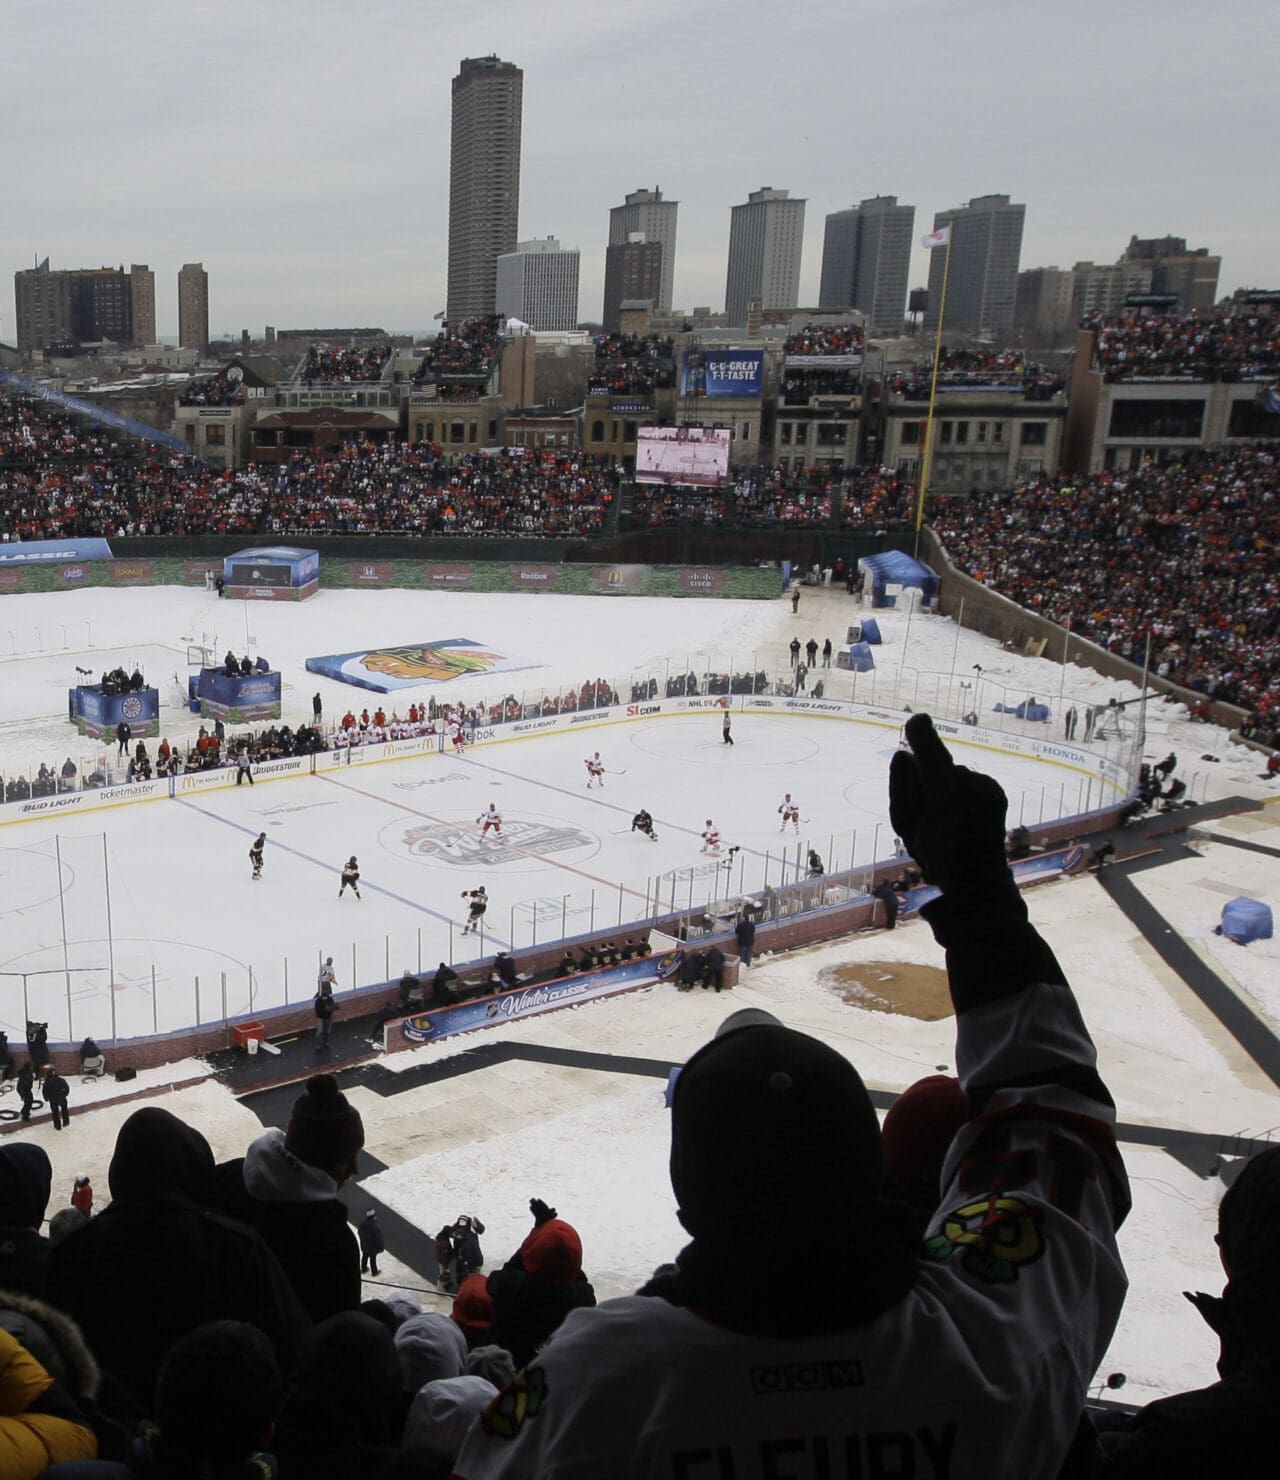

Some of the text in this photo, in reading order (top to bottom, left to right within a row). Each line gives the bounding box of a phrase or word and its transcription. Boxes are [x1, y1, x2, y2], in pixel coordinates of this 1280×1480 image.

[712, 371, 755, 380] T-T-TASTE
[520, 572, 548, 580] Reebok
[786, 701, 842, 712] BUD LIGHT
[570, 712, 610, 724] BRIDGESTONE
[513, 719, 557, 732] BUD LIGHT
[1042, 745, 1086, 764] HONDA
[253, 761, 301, 775] BRIDGESTONE
[100, 784, 156, 800] ticketmaster
[22, 796, 84, 812] BUD LIGHT
[500, 988, 551, 1016] Winter
[549, 982, 590, 1004] CLASSIC
[758, 1362, 863, 1389] CCM
